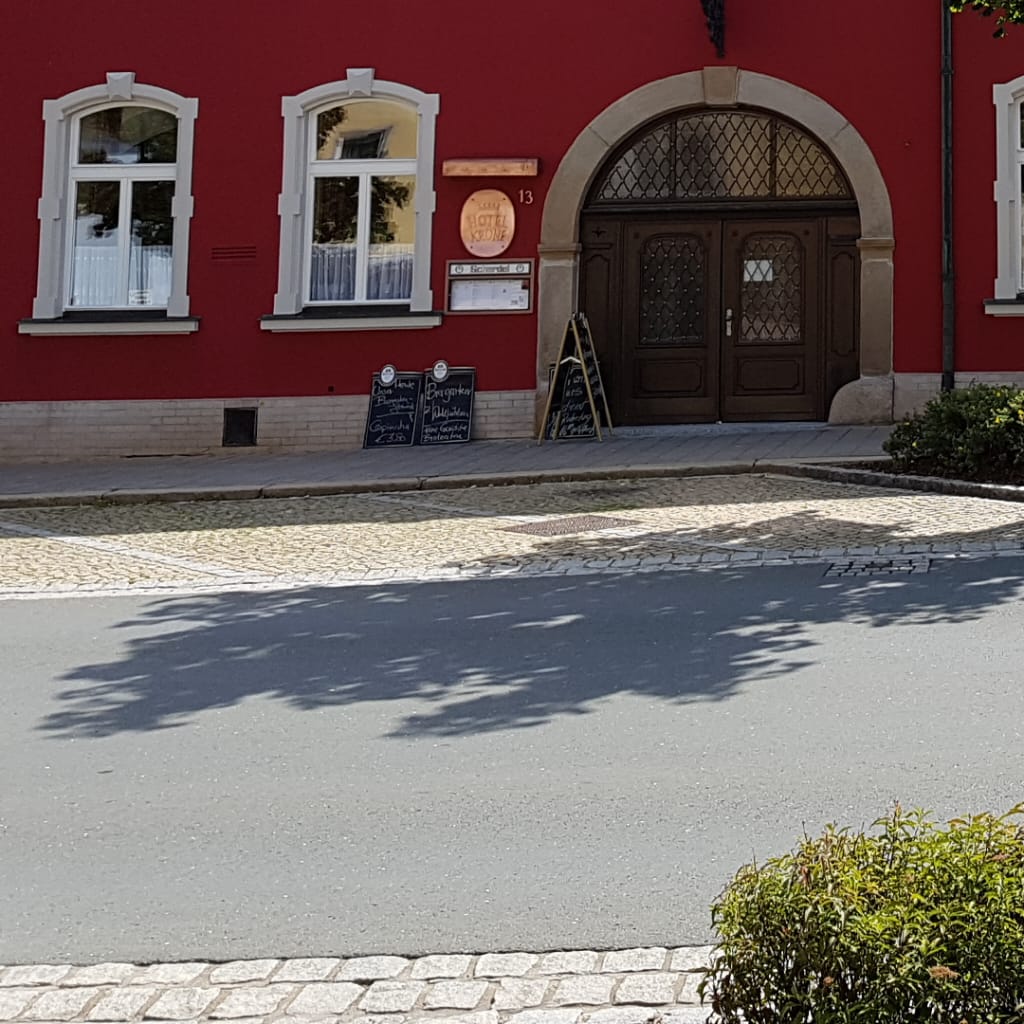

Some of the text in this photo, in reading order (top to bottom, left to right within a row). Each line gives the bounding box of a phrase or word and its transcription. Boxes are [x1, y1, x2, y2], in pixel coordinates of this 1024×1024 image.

[518, 189, 534, 205] 13
[467, 214, 508, 227] HOTEL
[470, 227, 508, 243] KRONE
